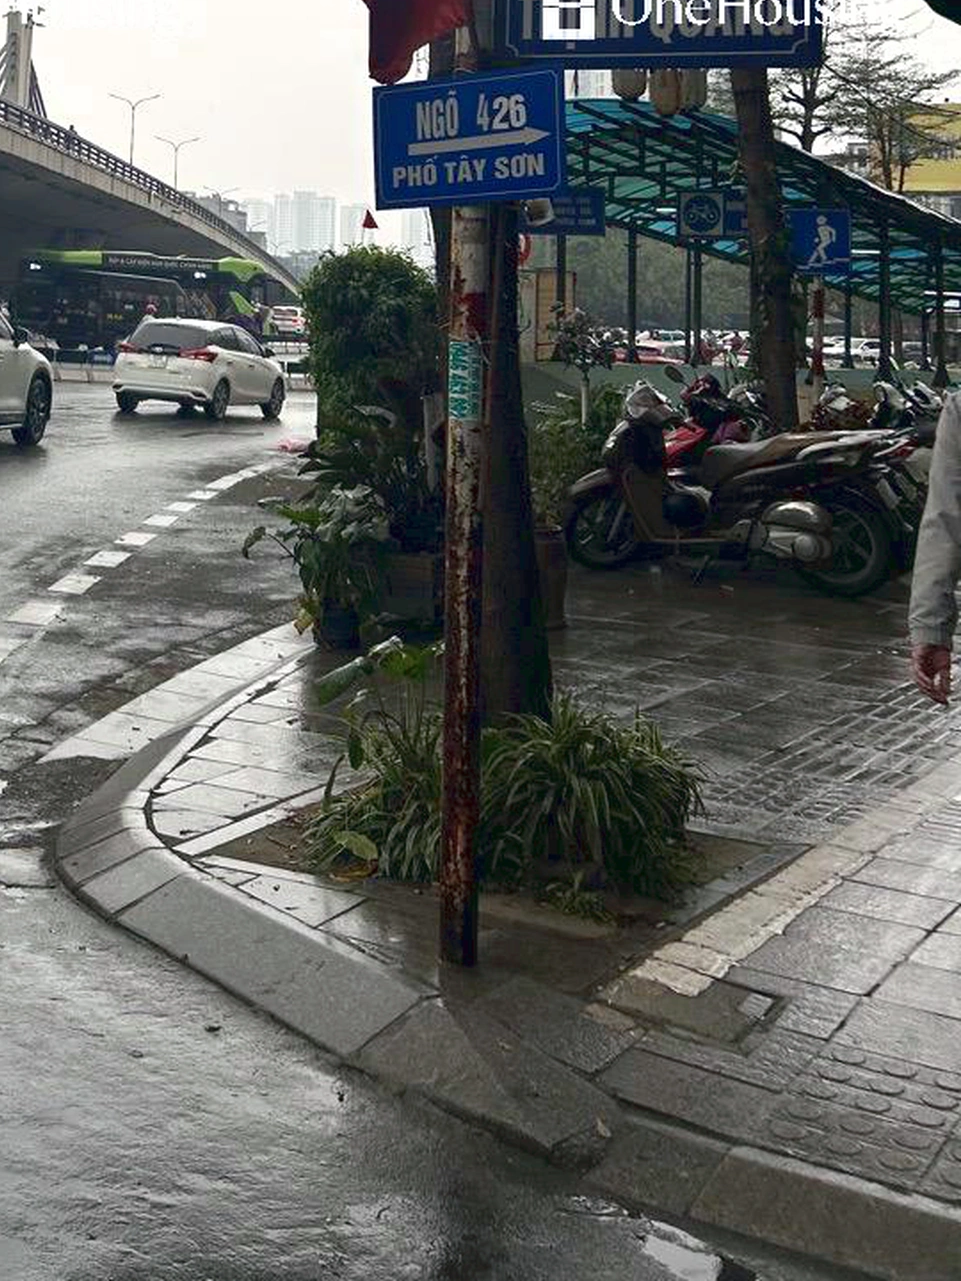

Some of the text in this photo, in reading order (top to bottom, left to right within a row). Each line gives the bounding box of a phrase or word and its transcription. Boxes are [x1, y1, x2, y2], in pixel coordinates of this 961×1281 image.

[476, 93, 527, 132] 426
[393, 152, 545, 189] PHỐ TÂY SƠN
